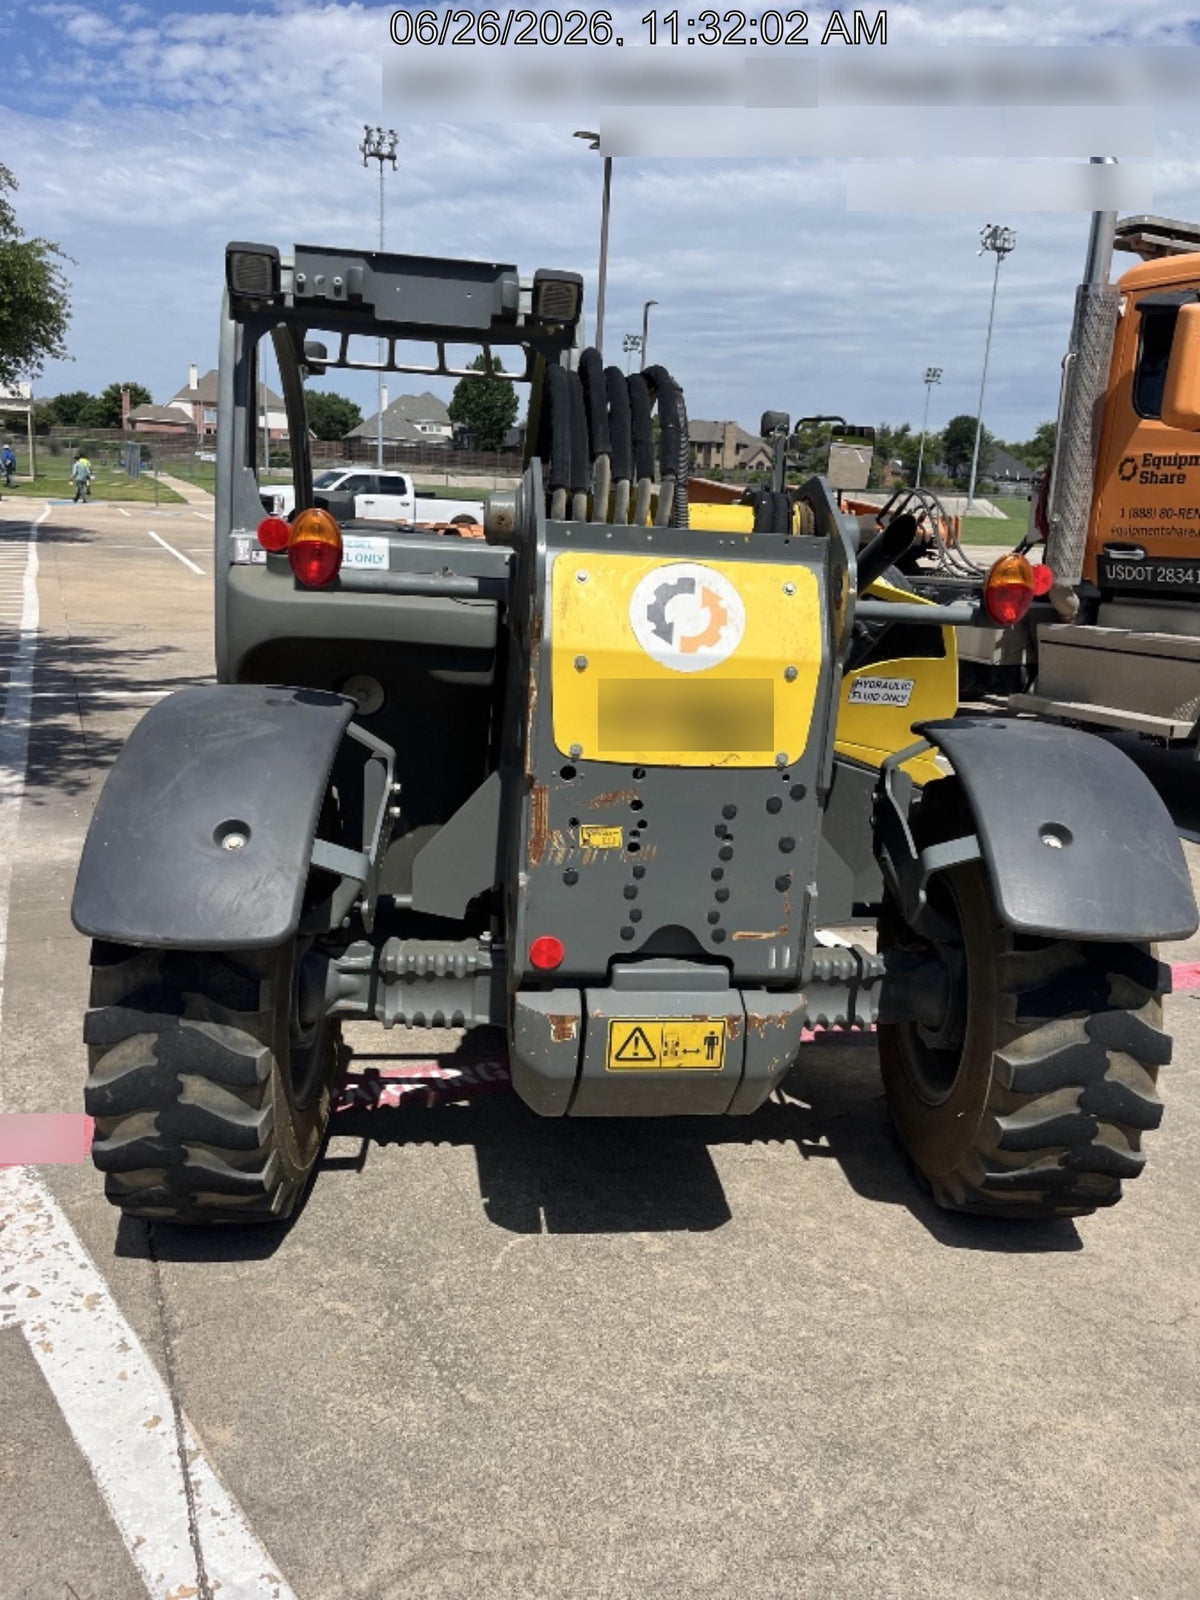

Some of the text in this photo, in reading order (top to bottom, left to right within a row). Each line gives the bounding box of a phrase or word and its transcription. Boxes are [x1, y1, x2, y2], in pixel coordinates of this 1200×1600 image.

[1139, 471, 1186, 484] Share
[1128, 508, 1156, 520] (888)
[355, 553, 385, 563] ONLY
[1106, 565, 1153, 580] USDOT
[855, 680, 911, 690] HYDRAULIC
[852, 691, 907, 703] FLUID ONLY
